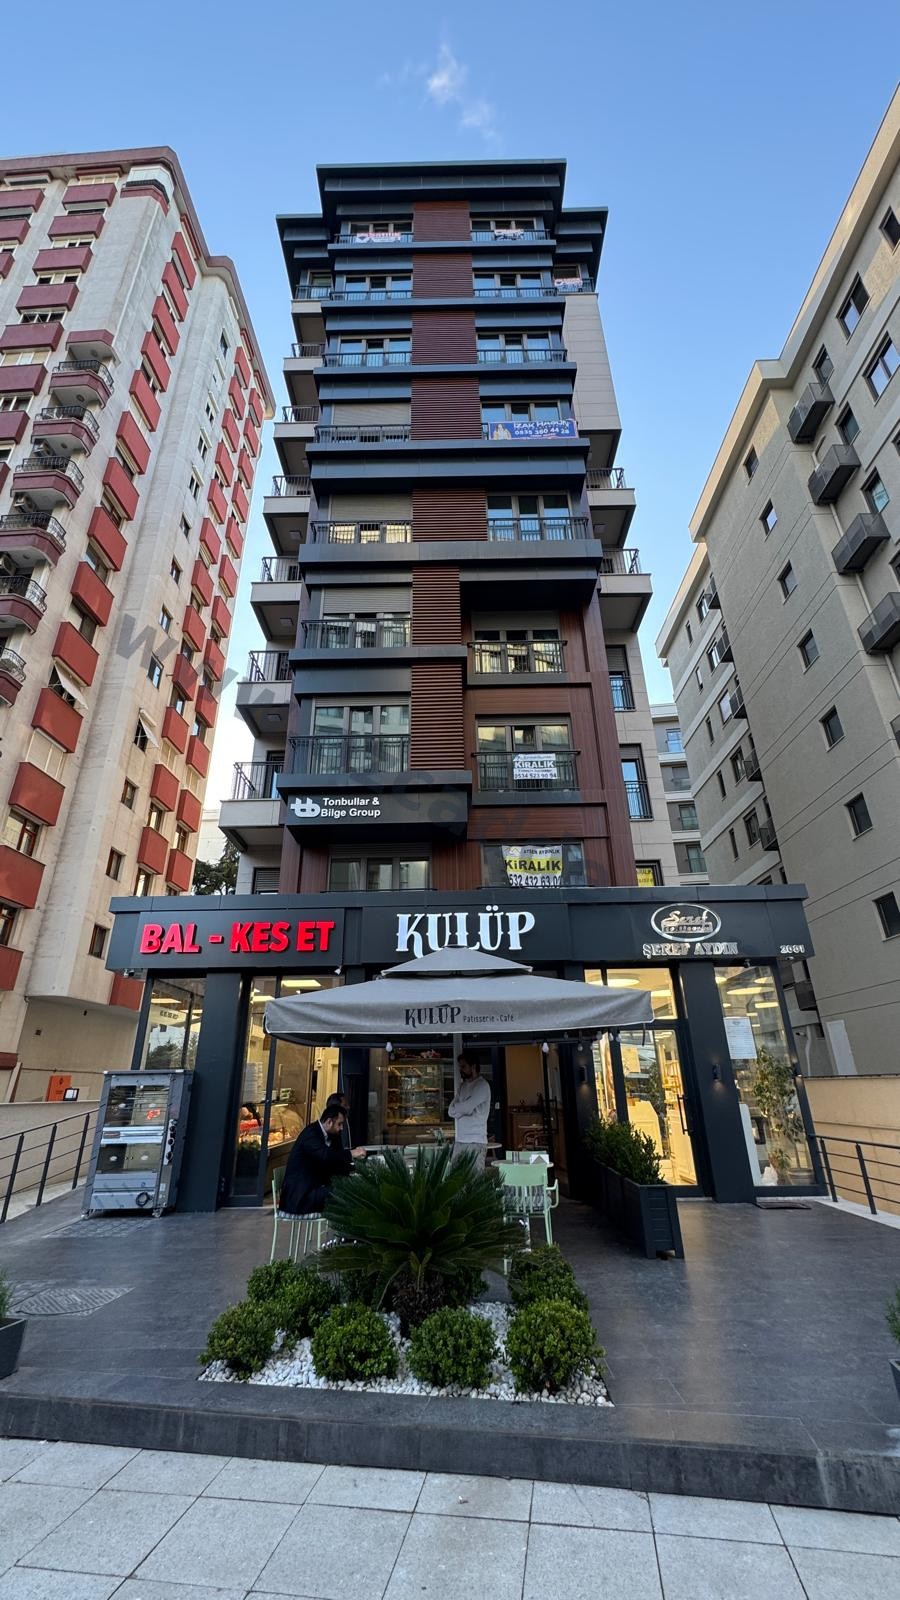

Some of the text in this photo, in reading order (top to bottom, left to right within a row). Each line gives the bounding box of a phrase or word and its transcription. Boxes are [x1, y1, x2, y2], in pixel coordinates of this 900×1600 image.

[322, 797, 380, 806] Tonbullar &
[321, 808, 381, 818] Bilge Group
[524, 875, 539, 886] 432
[395, 905, 536, 958] KULÜP
[139, 923, 201, 954] BAL
[228, 921, 291, 953] KES
[296, 921, 335, 952] ET
[642, 942, 739, 959] ŞEREF AYDIN
[463, 1015, 495, 1023] Patisserie
